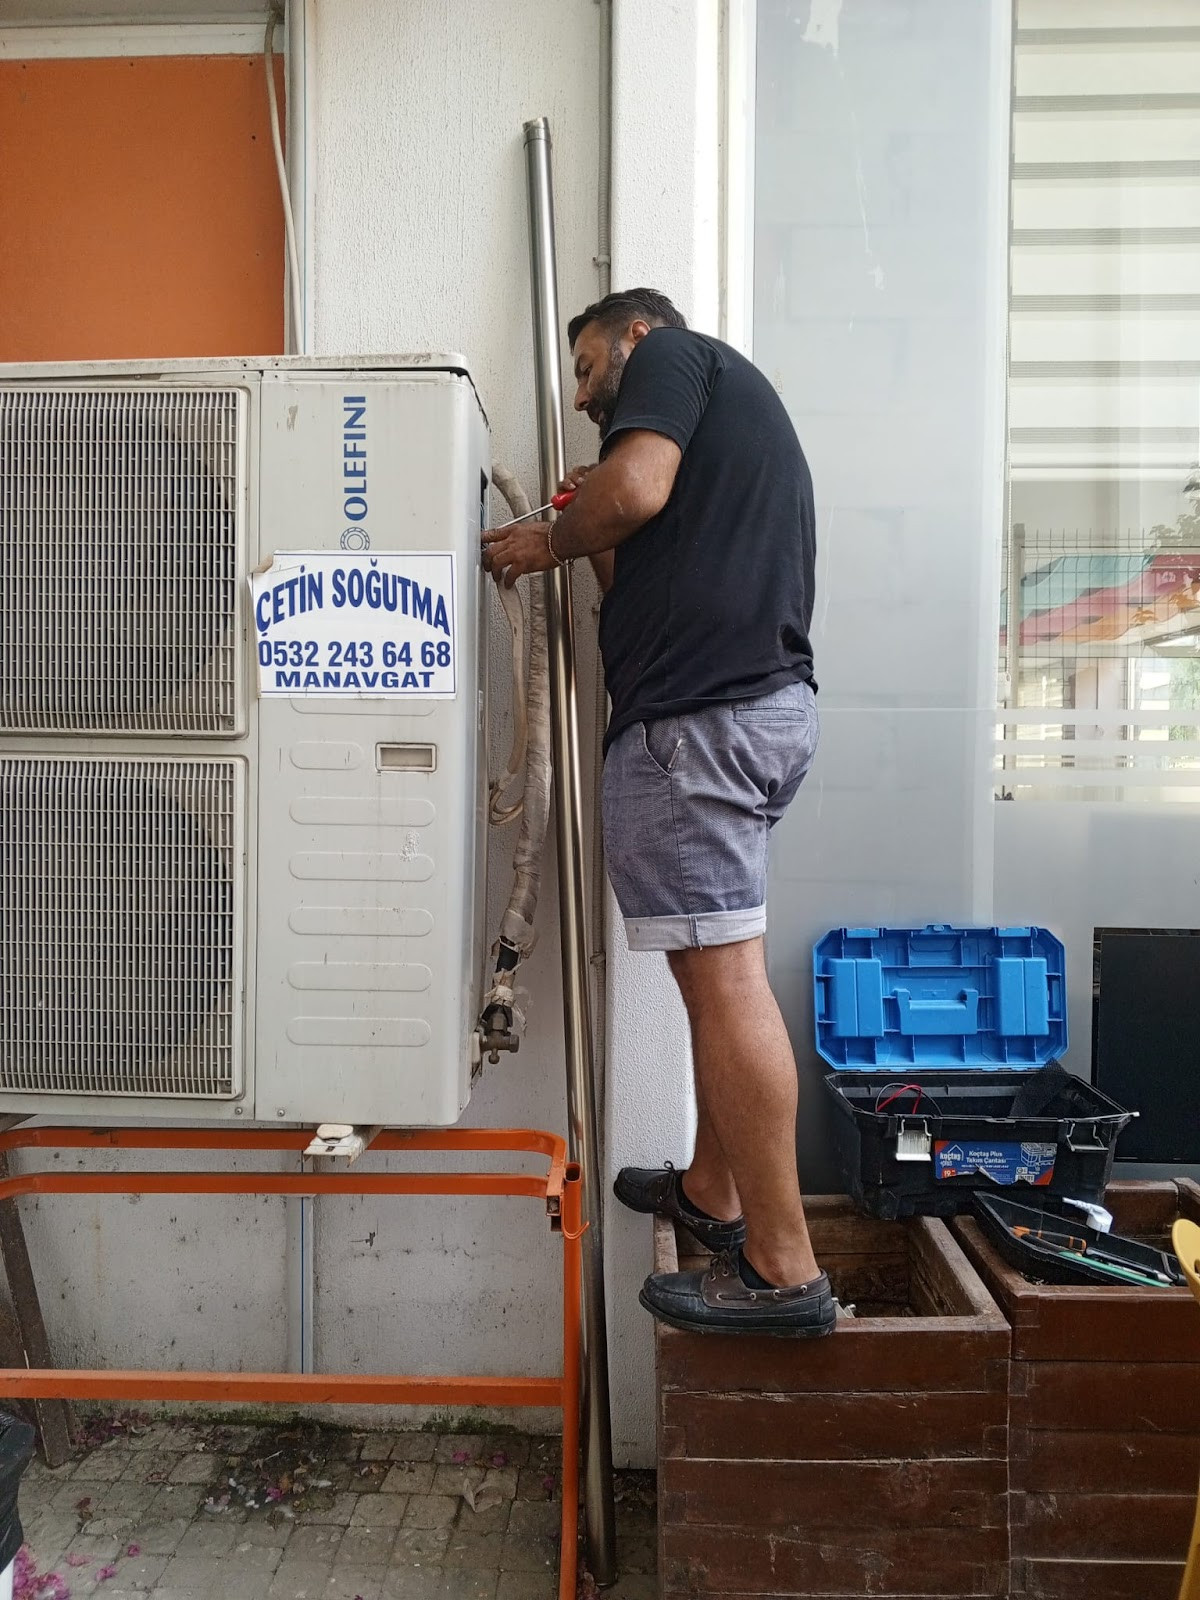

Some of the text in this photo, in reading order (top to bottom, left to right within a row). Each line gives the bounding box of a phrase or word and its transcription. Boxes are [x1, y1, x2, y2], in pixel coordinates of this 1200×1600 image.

[343, 396, 368, 521] OLEFINI
[256, 558, 451, 637] ÇETİN SOĞUTMA
[258, 640, 451, 667] 0532 243 64 68
[275, 671, 435, 688] MANAVGAT
